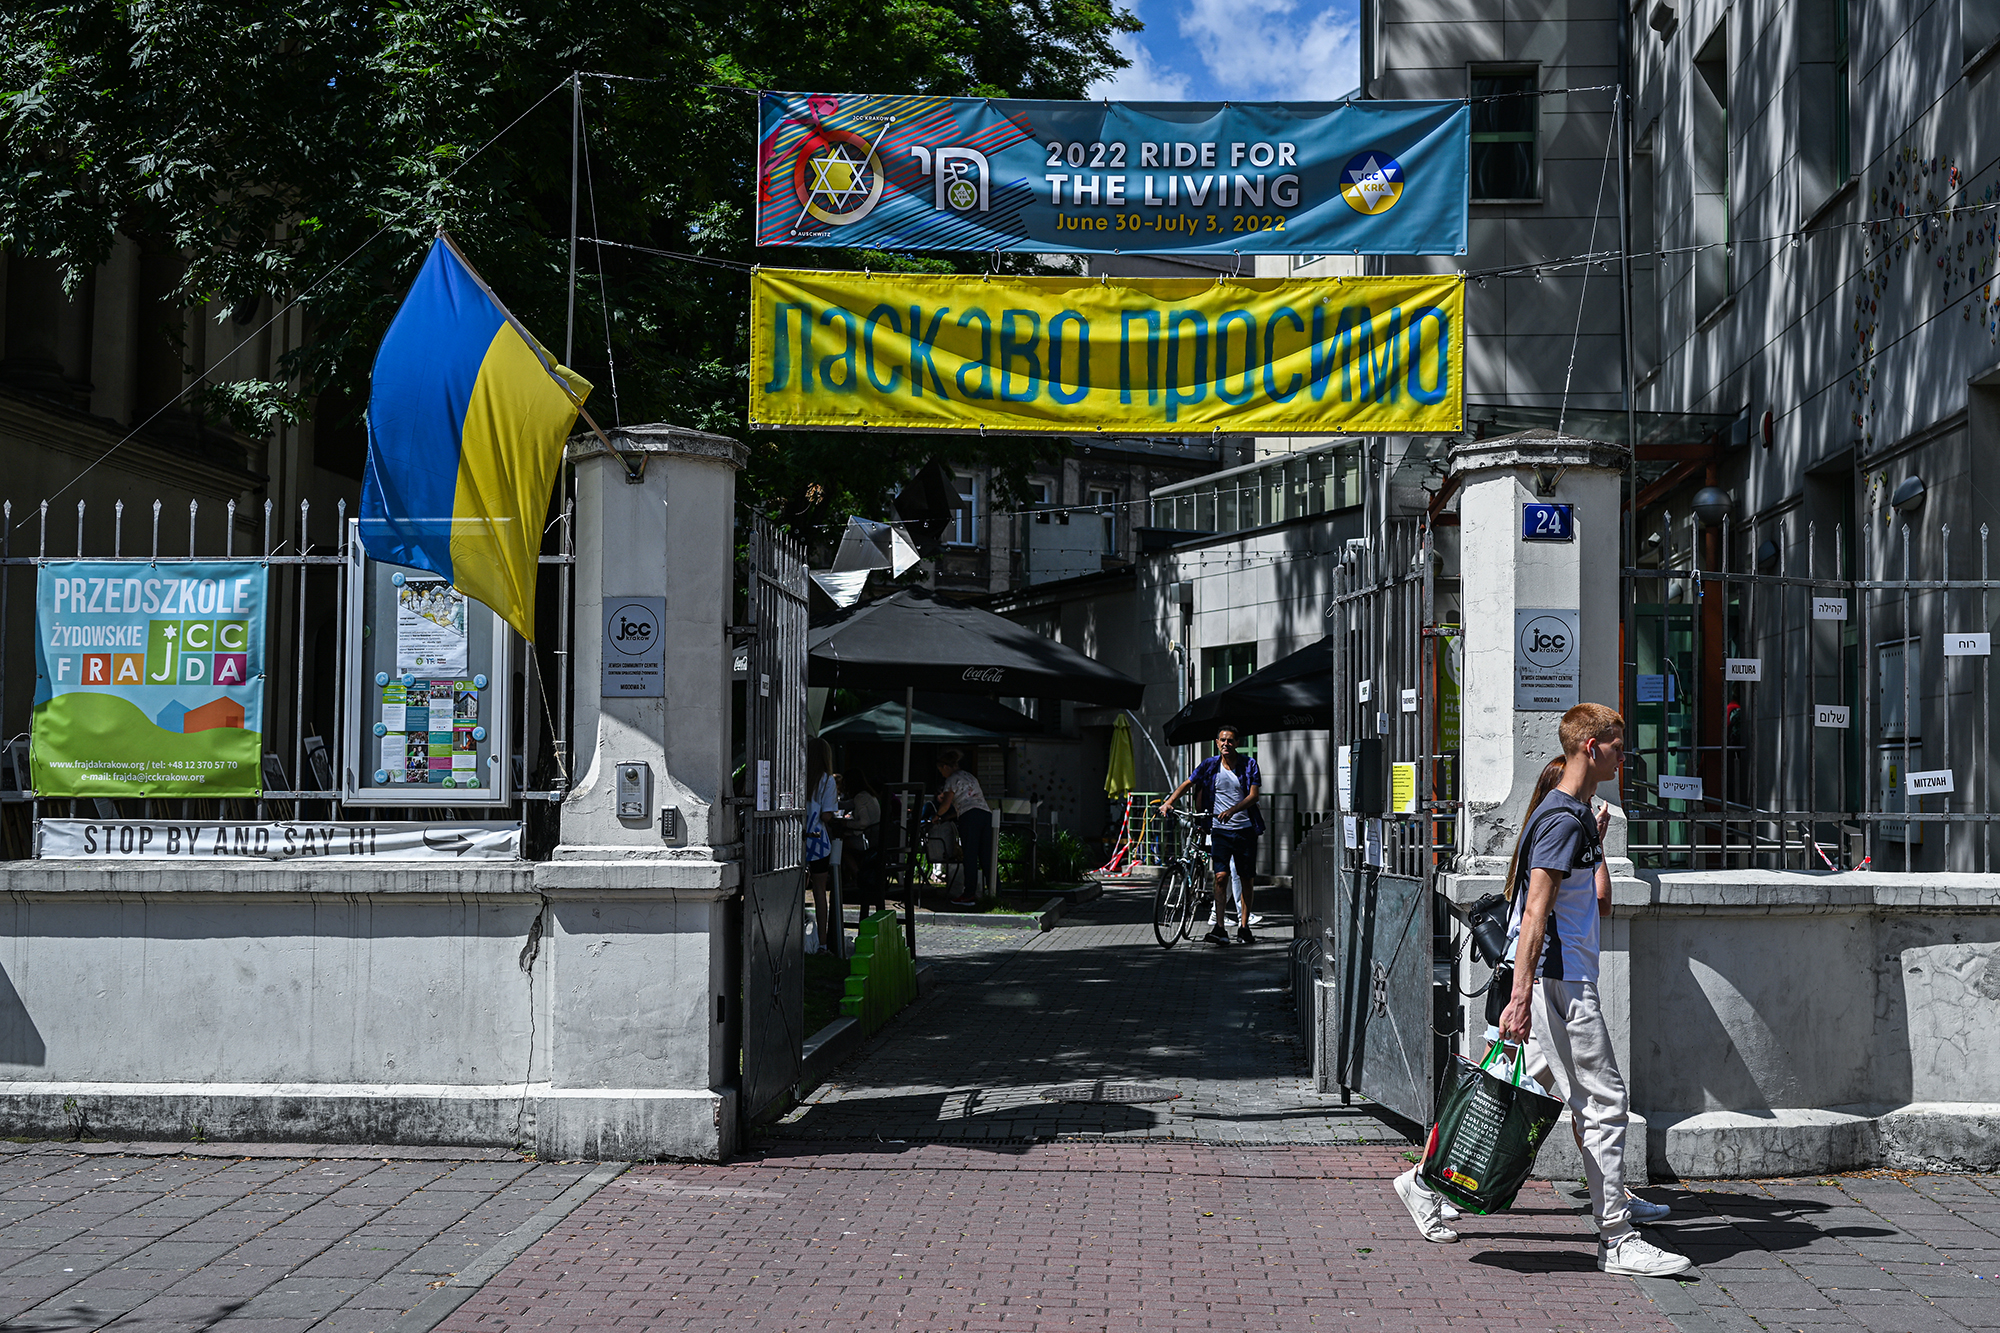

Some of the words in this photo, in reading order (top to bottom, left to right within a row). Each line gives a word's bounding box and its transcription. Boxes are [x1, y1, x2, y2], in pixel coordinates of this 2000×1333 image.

[1045, 141, 1126, 168] 2022
[1141, 142, 1216, 168] RIDE
[1230, 142, 1298, 168] FOR
[1358, 172, 1379, 181] JCC
[1045, 174, 1126, 206] THE
[1144, 174, 1299, 208] LIVING
[1364, 183, 1385, 192] KRK
[1056, 213, 1108, 231] June
[1206, 214, 1224, 234] 3,
[1233, 214, 1287, 232] 2022
[1536, 510, 1562, 534] 24
[54, 578, 250, 614] PRZEDSZKOLE
[1818, 602, 1843, 615] קהילה
[50, 622, 143, 647] ŻYDOWSKIE
[1958, 640, 1976, 649] רוח
[1731, 664, 1756, 674] KULTURA
[1820, 710, 1845, 724] שלום
[50, 759, 145, 772] www.frajdakrakow.org
[152, 761, 166, 769] tel:
[168, 761, 183, 769] +48
[185, 761, 195, 769] 12
[197, 761, 213, 769] 370
[215, 761, 226, 769] 57
[227, 761, 238, 769] 70
[81, 773, 111, 781] e-mail:
[113, 772, 205, 783] frajda@jcckrakow.org
[1913, 776, 1947, 788] MITZVAH
[84, 825, 153, 855] STOP
[167, 826, 202, 855] BY
[213, 826, 269, 856] AND
[282, 827, 333, 856] SAY
[350, 828, 376, 856] HI
